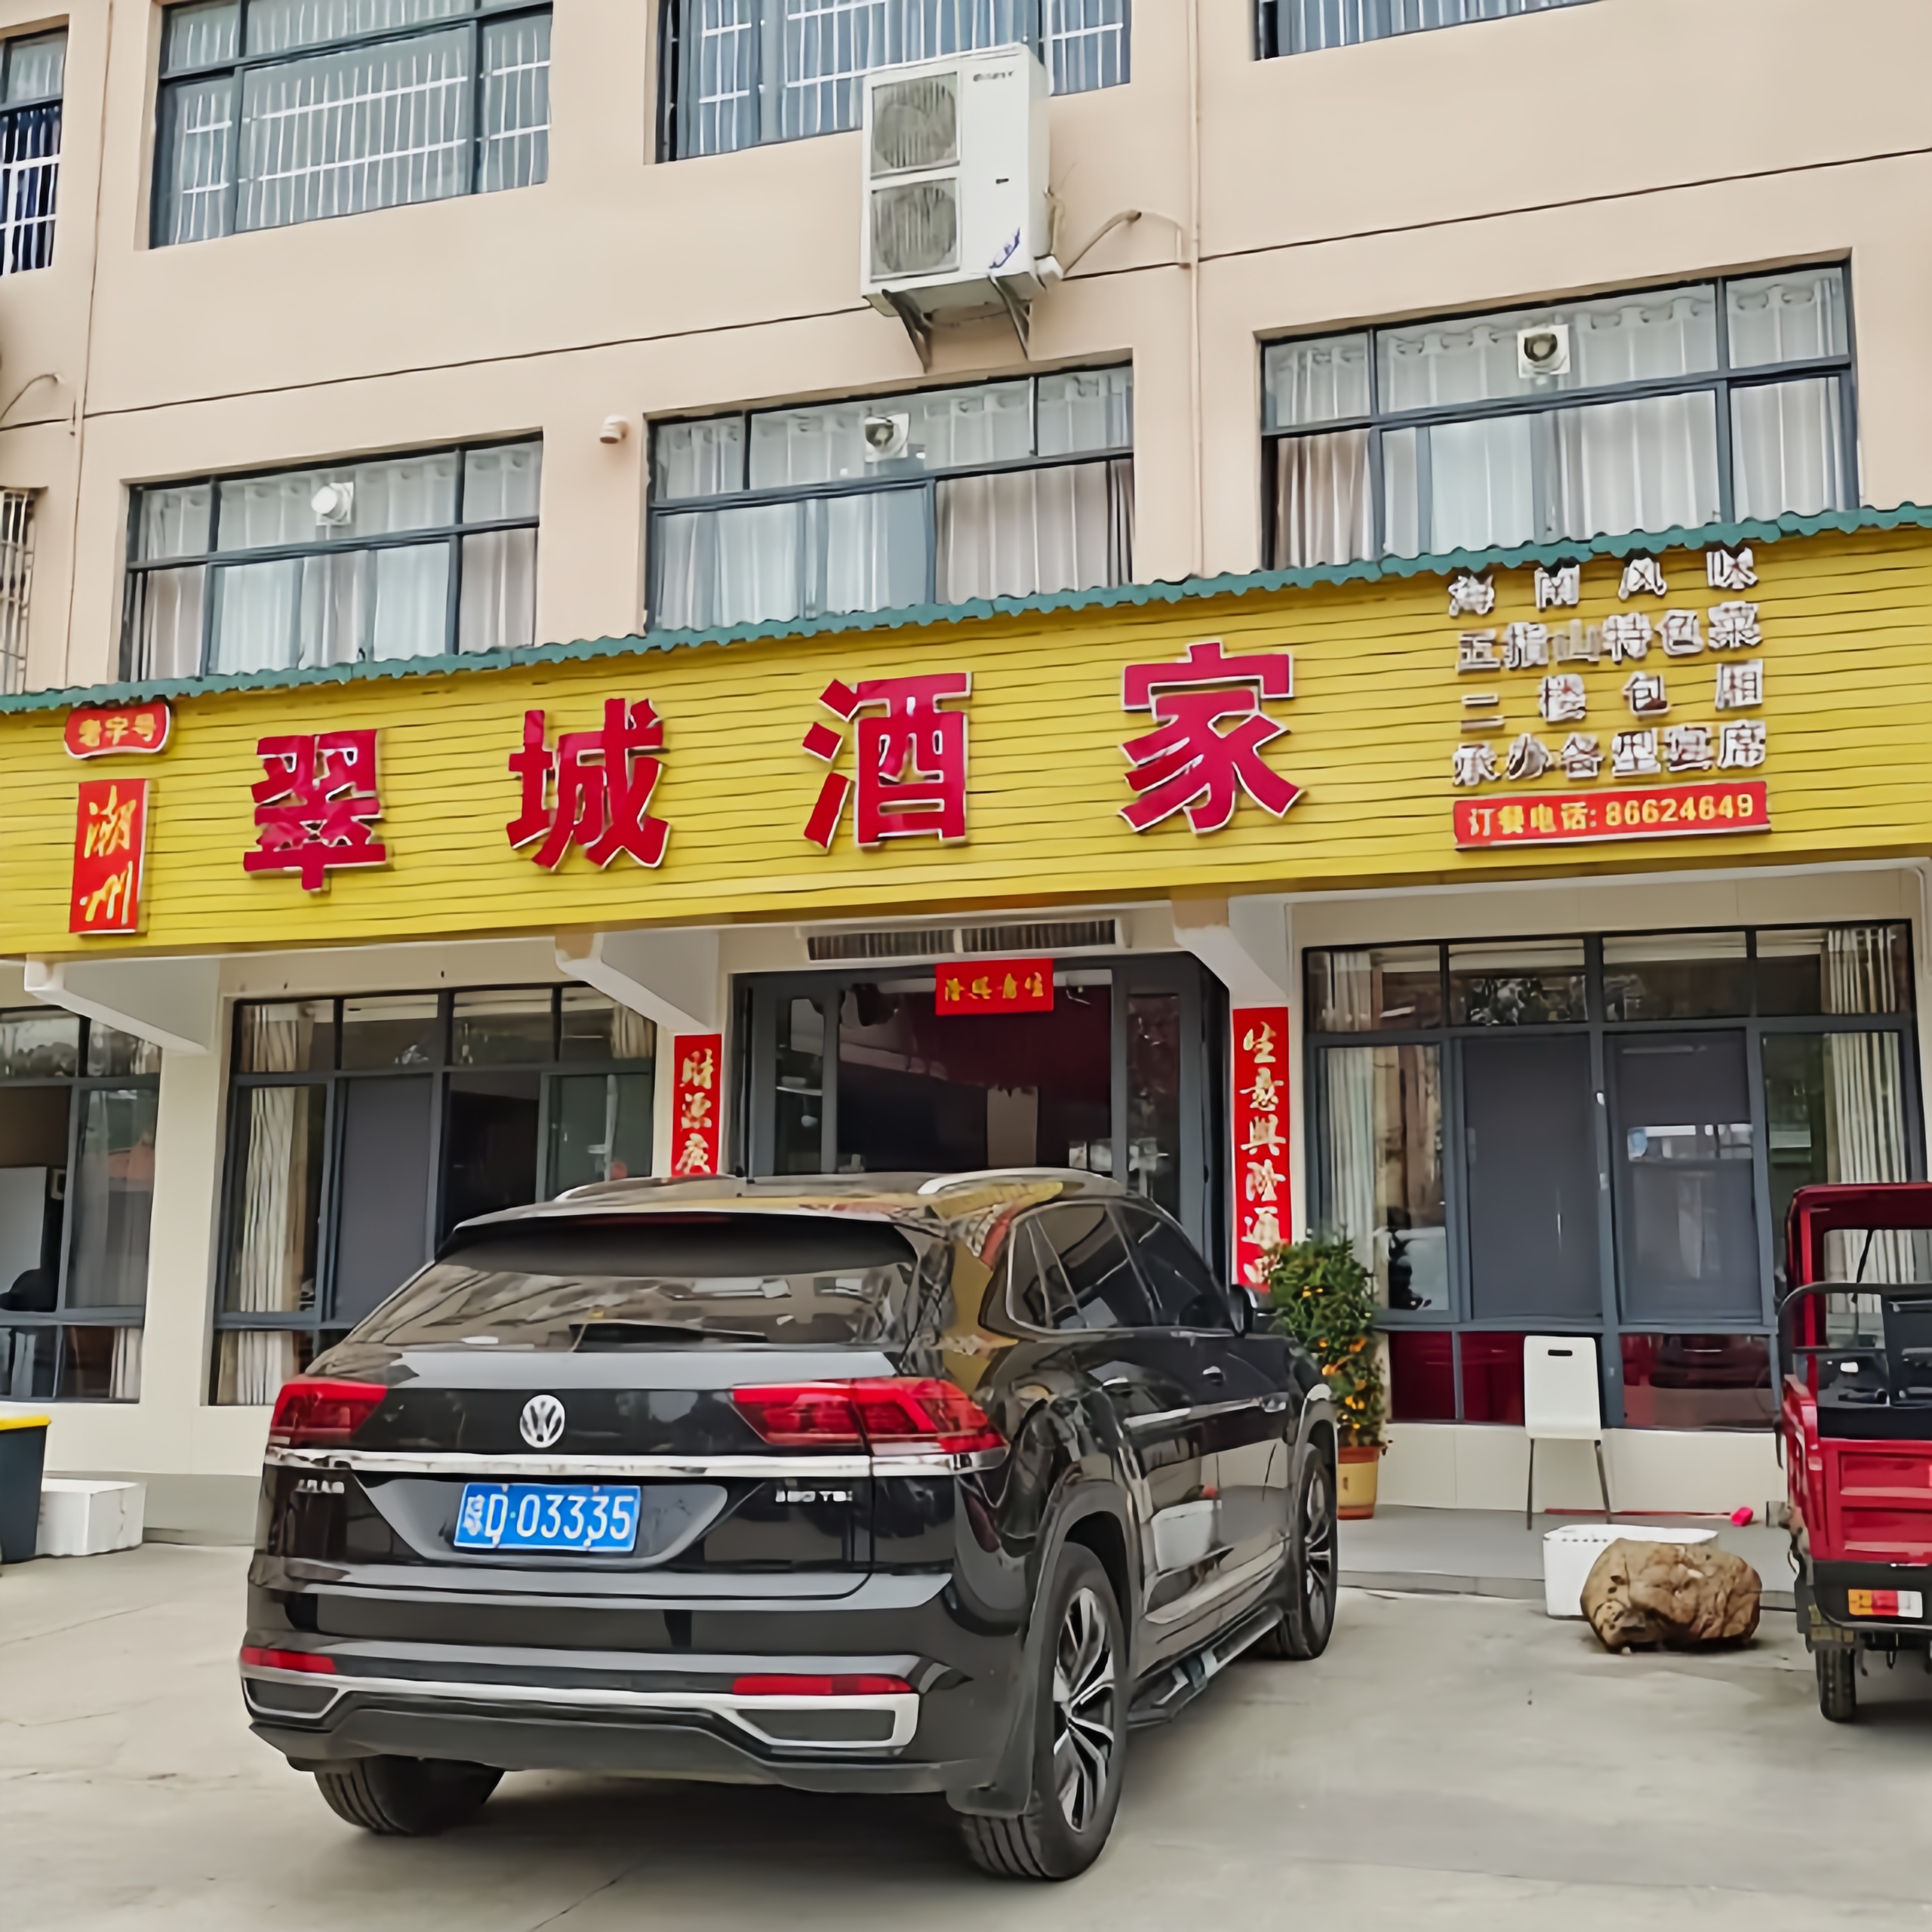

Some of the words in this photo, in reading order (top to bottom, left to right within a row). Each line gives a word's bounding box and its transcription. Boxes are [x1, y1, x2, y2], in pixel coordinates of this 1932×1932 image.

[1457, 601, 1762, 673] 五指山特色菜
[243, 640, 1304, 892] 翠城酒家
[1452, 720, 1766, 786] 承办各型宴席
